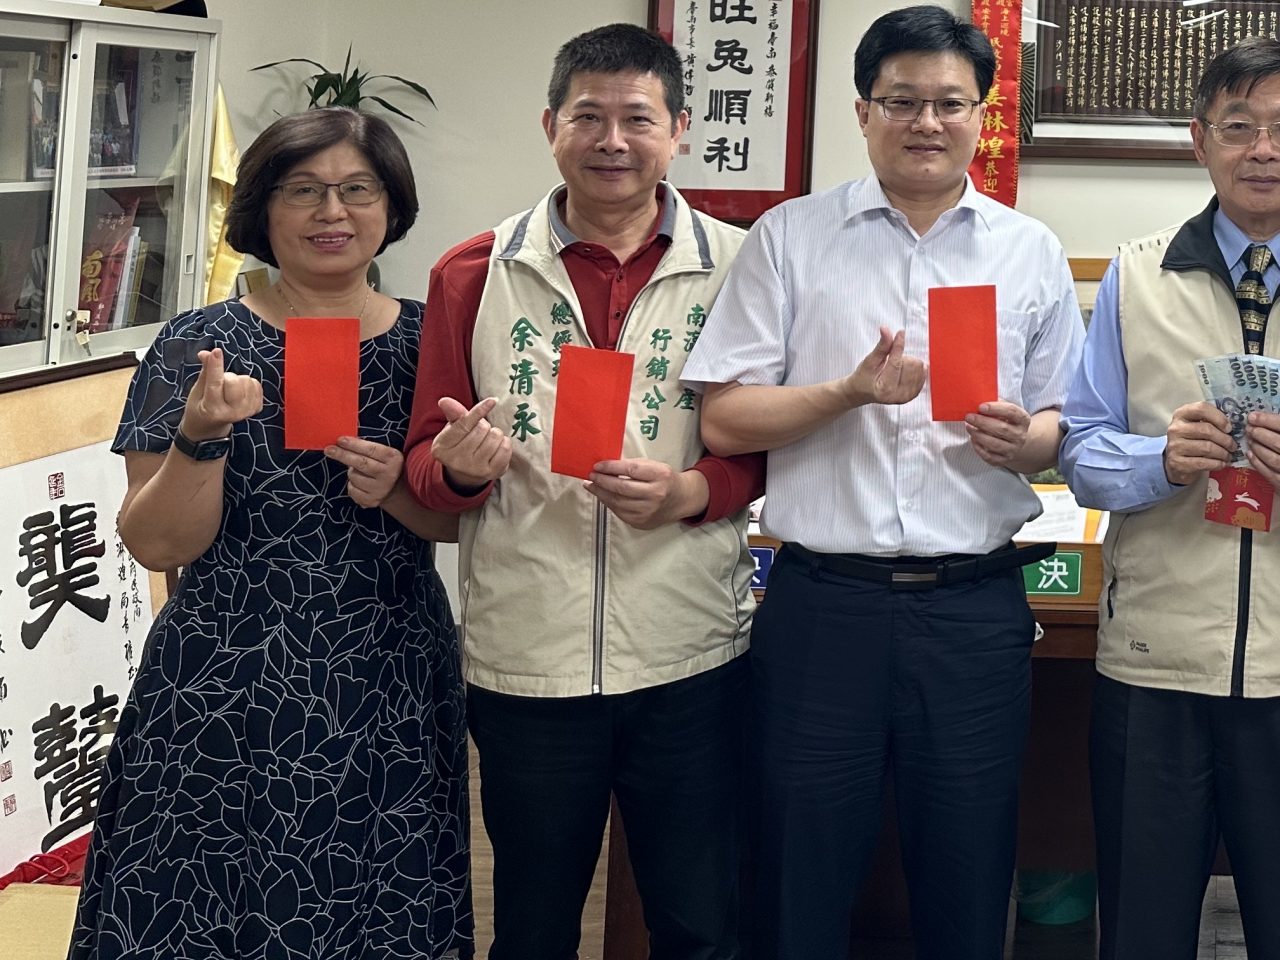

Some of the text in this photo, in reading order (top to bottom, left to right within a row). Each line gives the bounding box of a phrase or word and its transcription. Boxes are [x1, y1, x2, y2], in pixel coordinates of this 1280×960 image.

[509, 316, 541, 442] 余清永
[639, 328, 673, 440] 行銷公司
[1198, 363, 1210, 385] 1000
[1229, 356, 1246, 387] 1000
[1242, 360, 1259, 389] 1000
[1270, 368, 1279, 397] 1000
[1037, 557, 1069, 590] 決
